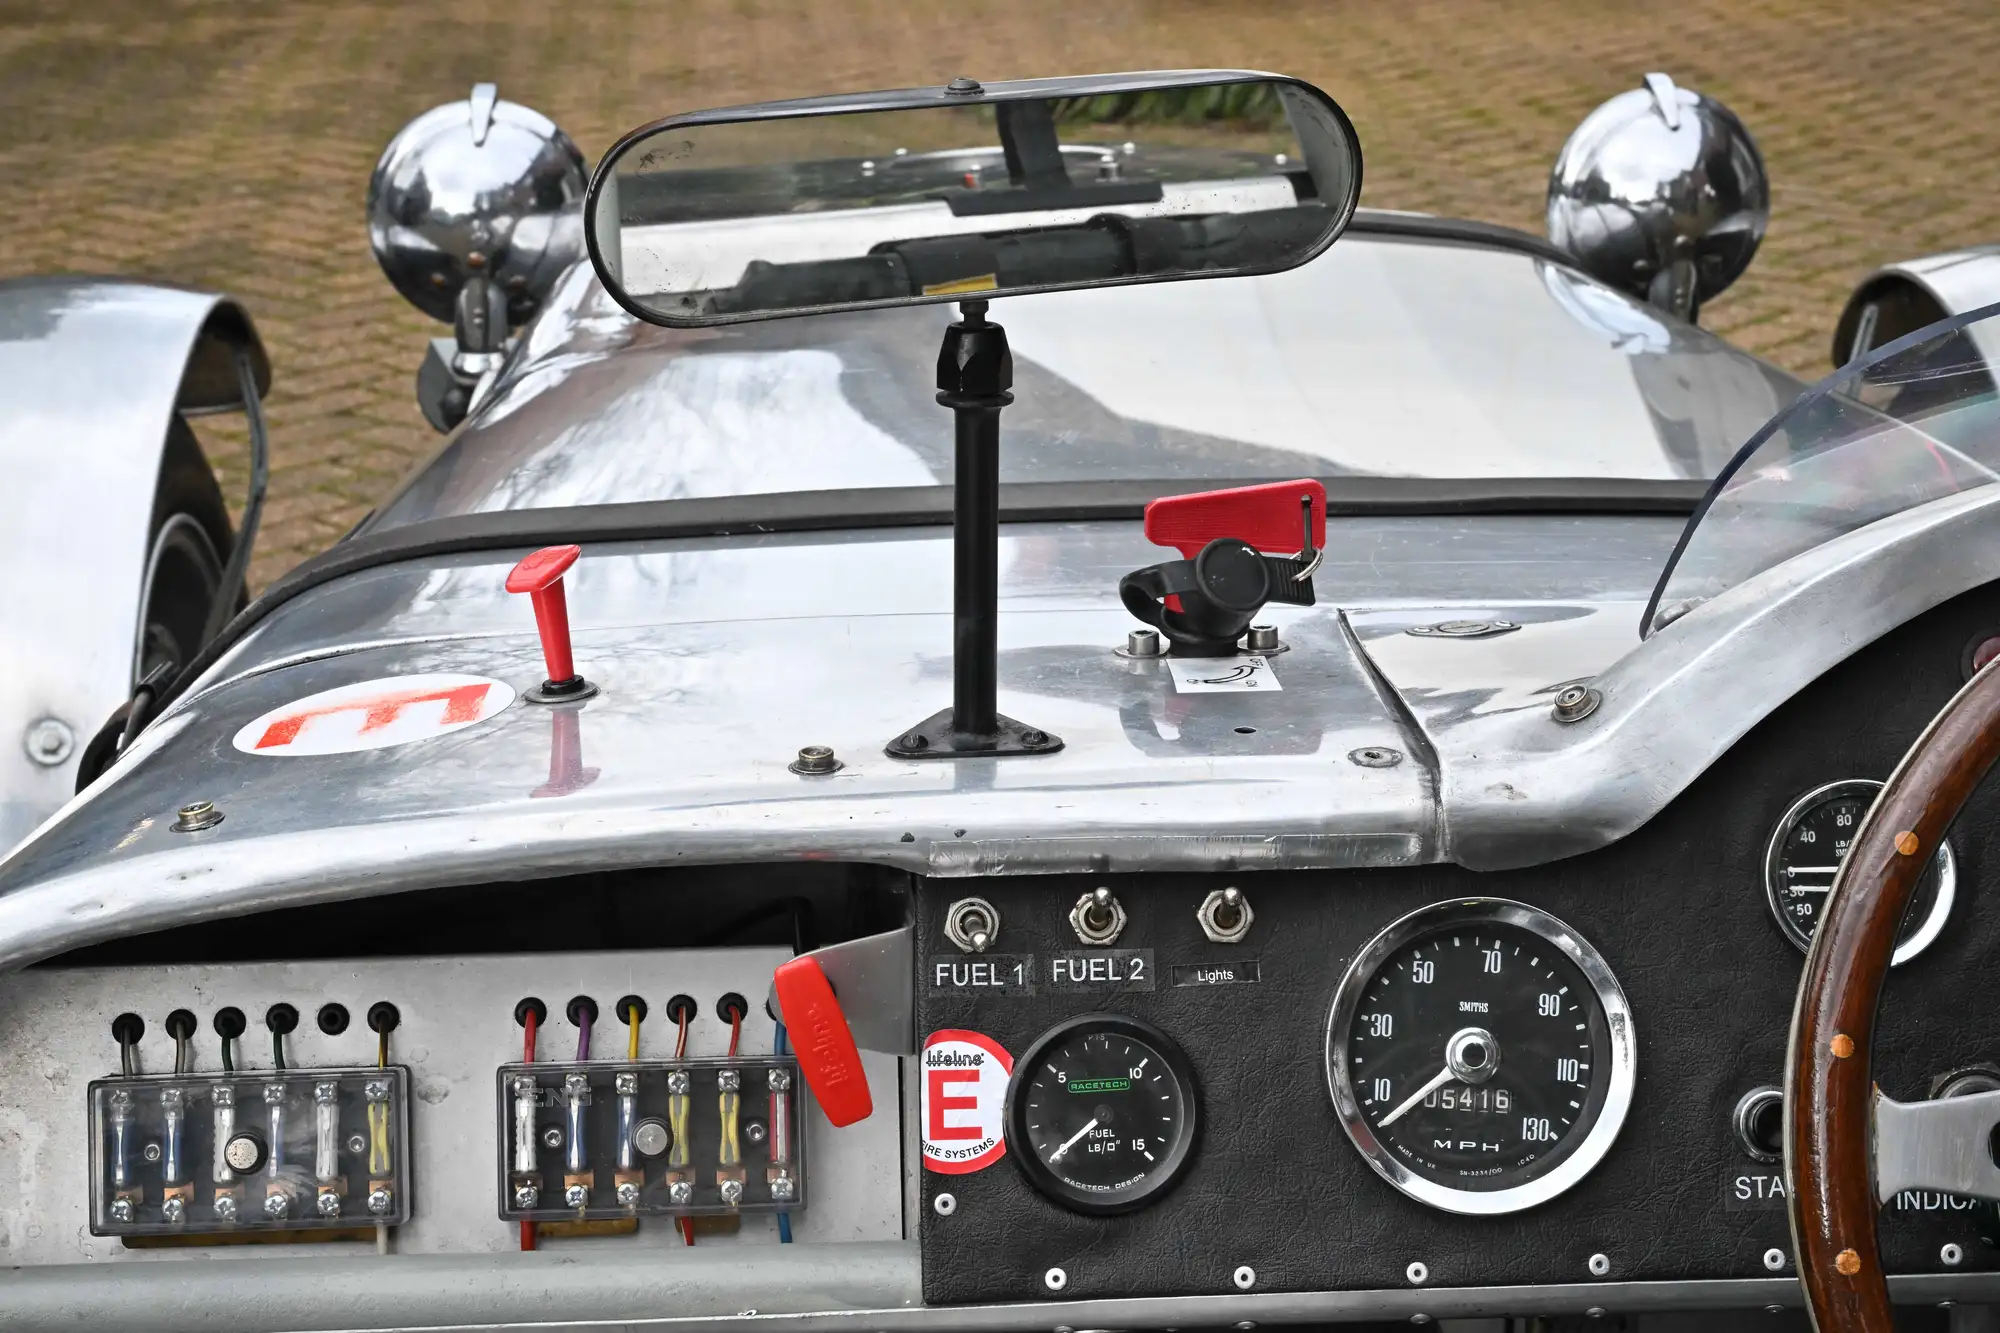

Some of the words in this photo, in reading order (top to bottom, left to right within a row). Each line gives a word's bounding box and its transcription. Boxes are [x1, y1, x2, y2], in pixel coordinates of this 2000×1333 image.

[1836, 814, 1852, 826] 80
[1800, 831, 1816, 843] 40
[1835, 840, 1852, 848] LB/
[1797, 903, 1812, 916] 50
[1052, 958, 1123, 983] FUEL
[1130, 957, 1145, 981] 2
[1482, 950, 1501, 974] 70
[936, 963, 1004, 987] FUEL
[1013, 964, 1024, 986] 1
[1197, 968, 1235, 983] Lights
[1412, 961, 1434, 984] 50
[1459, 1001, 1489, 1013] SMITHS
[1538, 993, 1560, 1017] 90
[1370, 1014, 1393, 1037] 30
[1058, 1071, 1067, 1083] 5
[1130, 1067, 1143, 1079] 10
[1557, 1058, 1578, 1082] 110
[1071, 1081, 1128, 1090] RACETECH
[1374, 1078, 1391, 1102] 10
[928, 1069, 983, 1141] E
[1089, 1129, 1115, 1139] FUEL
[1522, 1117, 1549, 1141] 130
[944, 1137, 995, 1159] SYSTEMS
[1132, 1139, 1145, 1151] 15
[1397, 1144, 1413, 1158] MADE
[1434, 1139, 1499, 1152] MPH
[1064, 1177, 1110, 1191] RACETECH
[1115, 1172, 1145, 1190] DESIGN
[1735, 1175, 1786, 1200] STA
